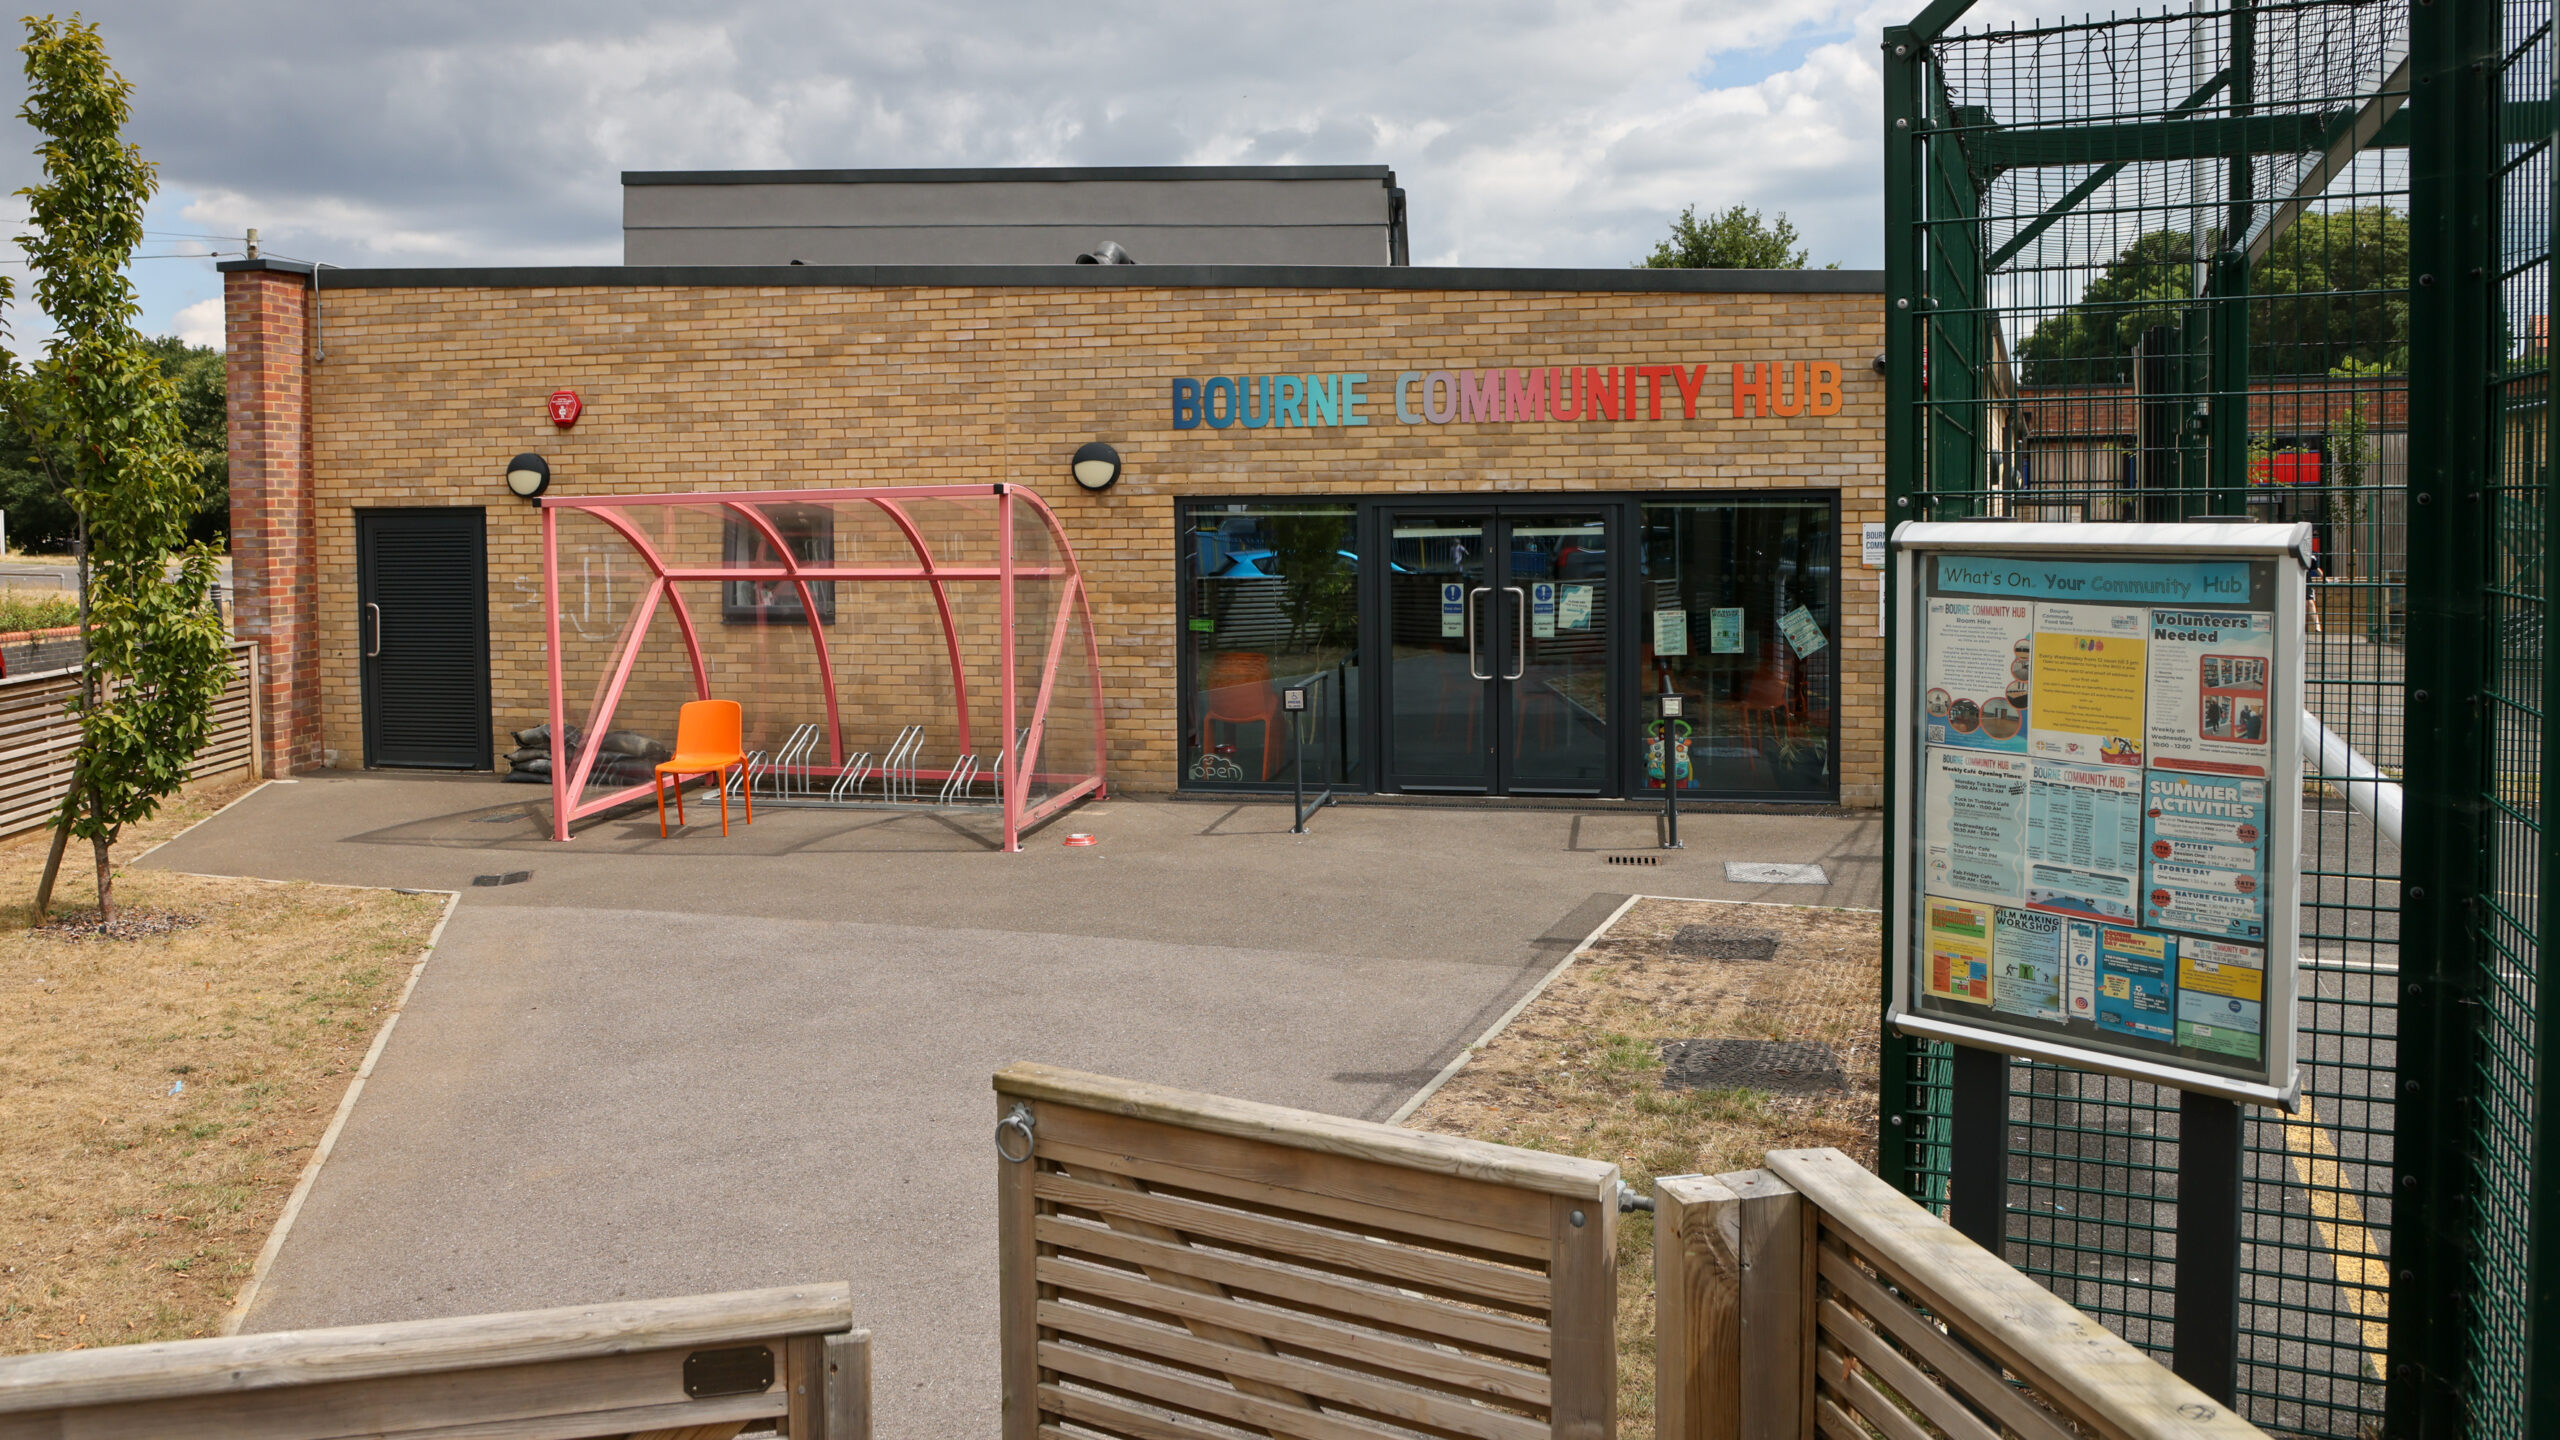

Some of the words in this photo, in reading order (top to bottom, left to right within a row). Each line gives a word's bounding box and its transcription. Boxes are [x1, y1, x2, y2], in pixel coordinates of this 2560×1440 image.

[1172, 372, 1369, 430] BOURNE
[1396, 364, 1709, 425] COMMUNITY
[1732, 361, 1844, 418] HUB
[1945, 567, 2001, 586] What's
[2045, 573, 2086, 591] Your
[2090, 575, 2192, 600] Community
[2203, 575, 2243, 593] Hub
[1945, 603, 1970, 615] BOURNE
[1972, 604, 2010, 618] COMMUNITY
[2012, 606, 2026, 618] HUB
[2042, 613, 2073, 621] Community
[2155, 612, 2248, 628] Volunteers
[2154, 628, 2218, 643] Needed
[2152, 726, 2175, 734] Weekly
[2151, 734, 2193, 742] Wednesdays
[1943, 754, 1963, 765] BOURNE
[1964, 755, 1996, 769] COMMUNITY
[1998, 760, 2009, 770] HUB
[1194, 766, 1238, 780] open
[1942, 766, 1962, 774] Weekly
[1978, 770, 2003, 778] Opening
[2033, 766, 2061, 781] BOURNE
[2063, 770, 2107, 786] COMMUNITY
[2109, 776, 2126, 789] HUB
[2150, 780, 2239, 801] SUMMER
[2149, 796, 2254, 819] ACTIVITIES
[1953, 822, 1984, 830] Wednesday
[2174, 841, 2214, 851] POTTERY
[2158, 865, 2191, 874] SPORTS
[2193, 868, 2211, 876] DAY
[2175, 890, 2210, 900] NATURE
[2212, 895, 2246, 904] CRAFTS
[1996, 917, 2058, 933] WORKSHOP
[2020, 913, 2060, 926] MAKING
